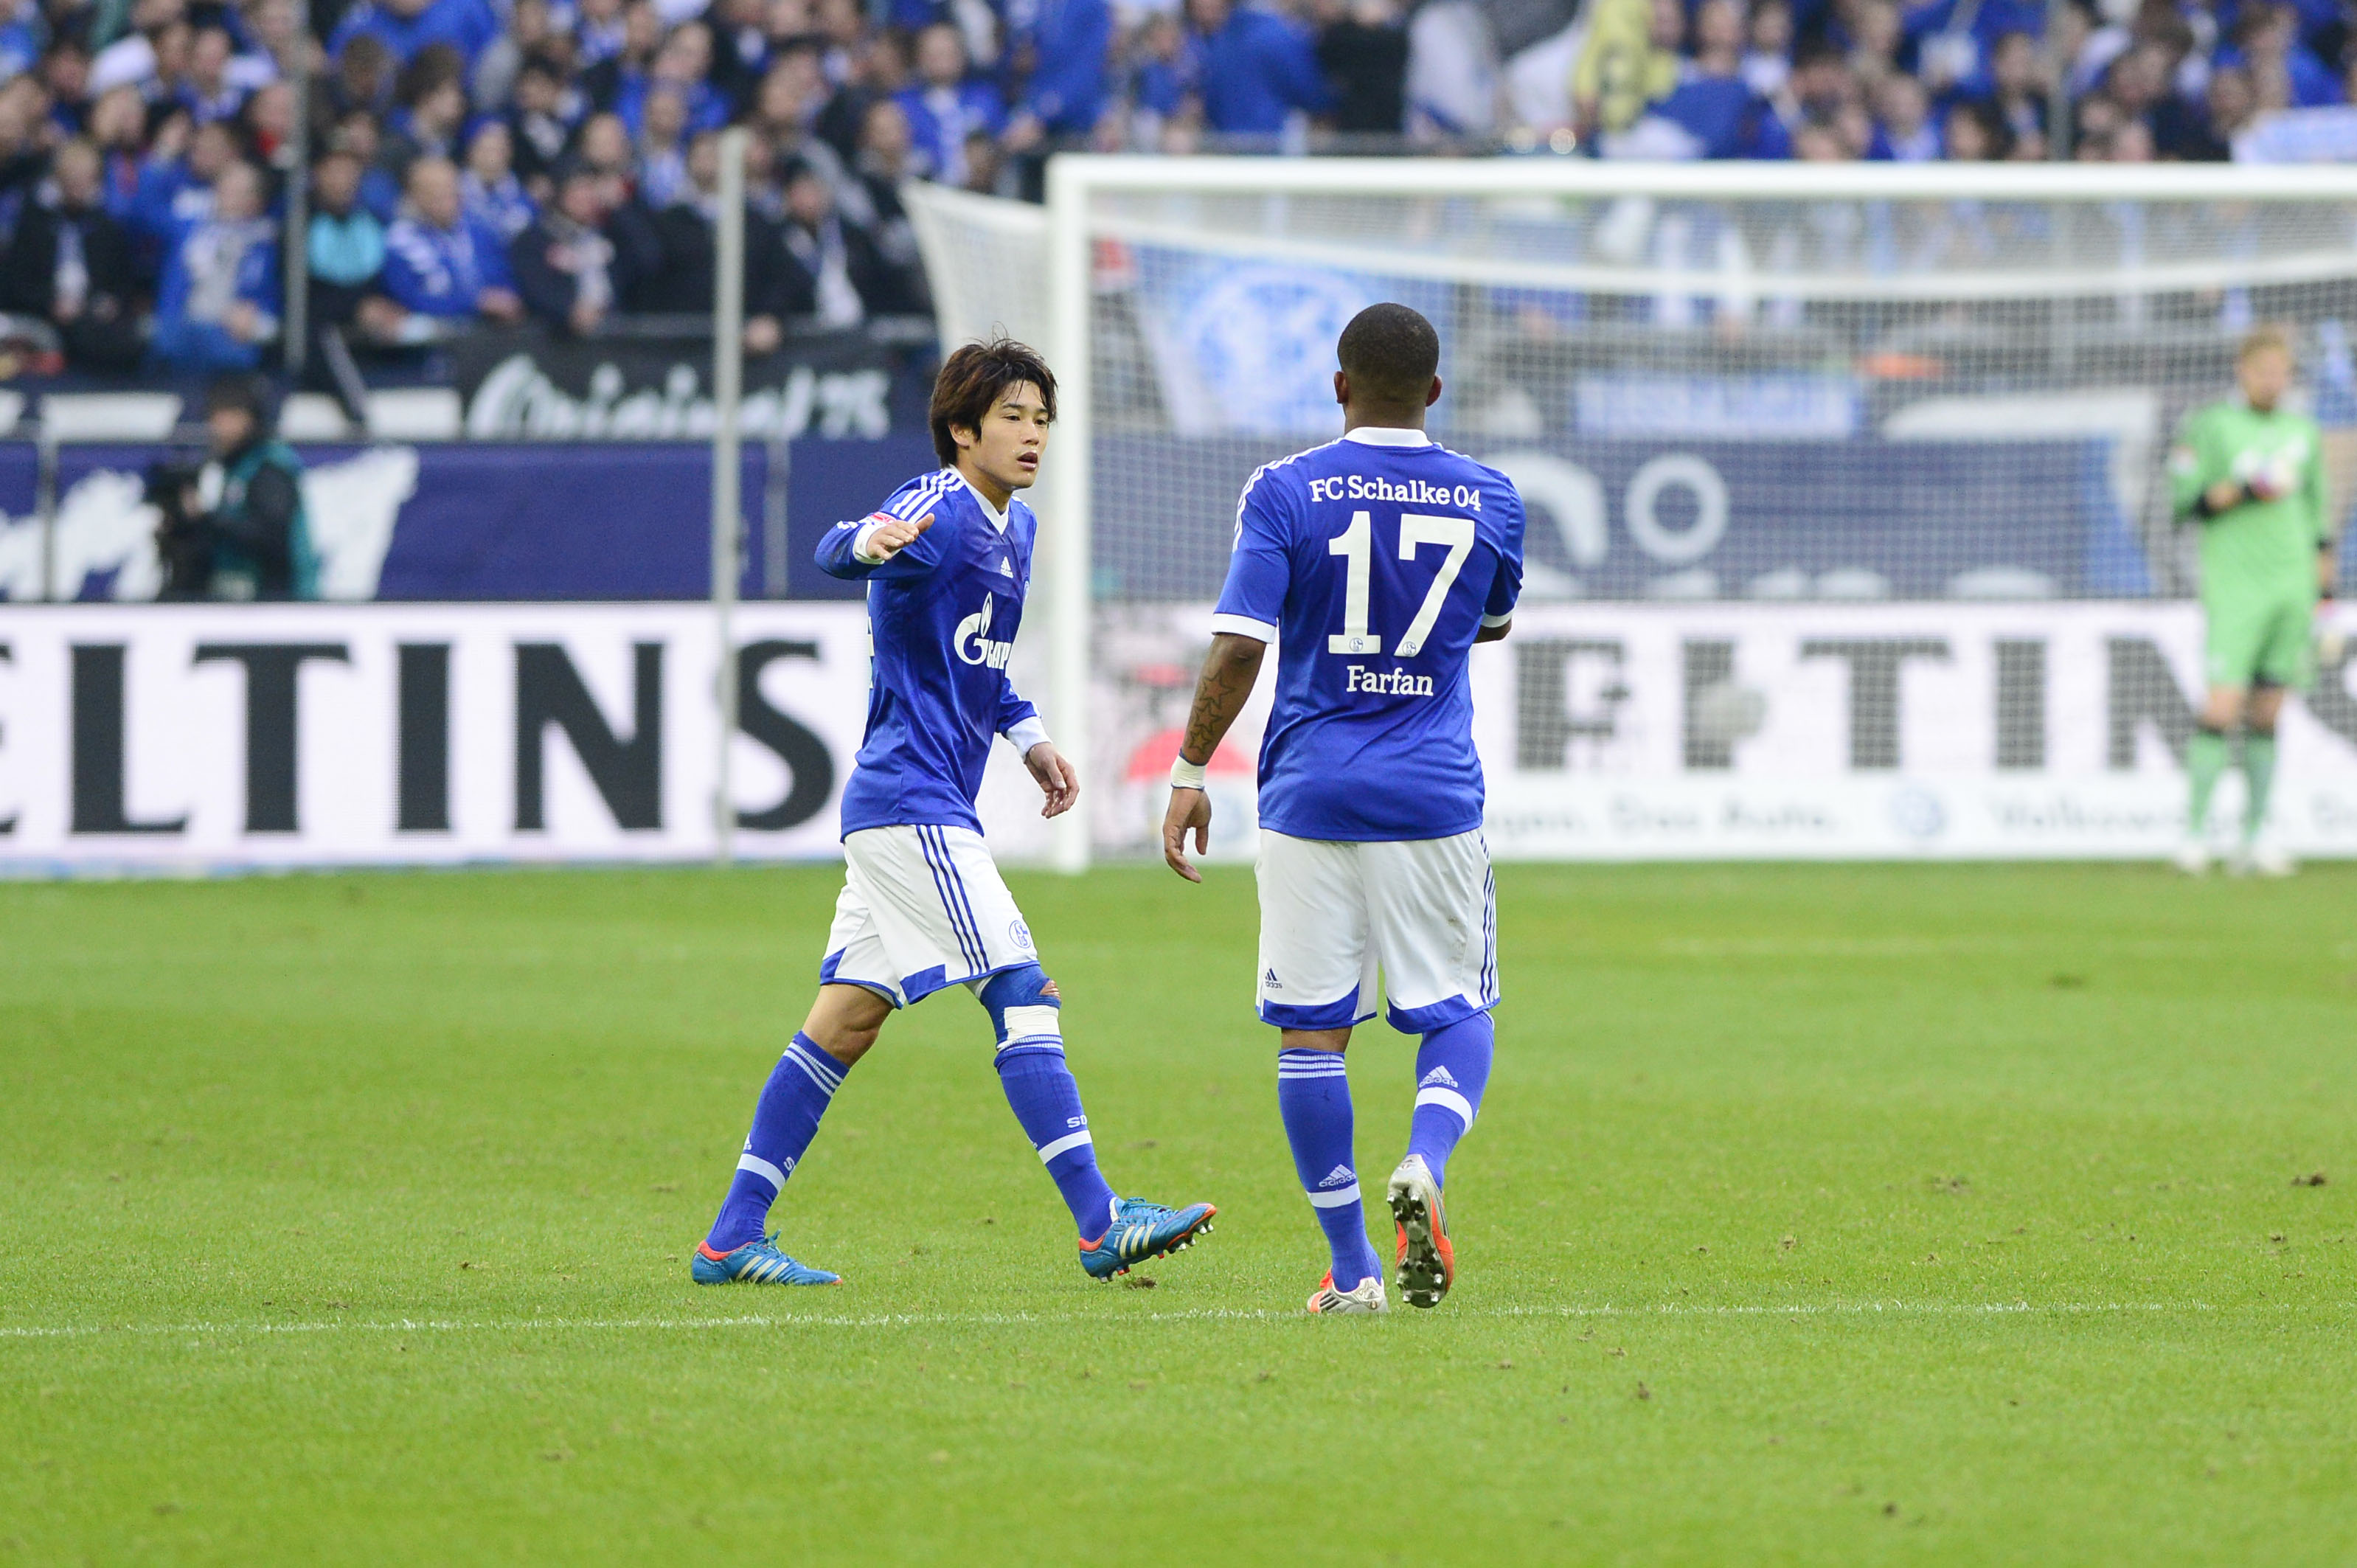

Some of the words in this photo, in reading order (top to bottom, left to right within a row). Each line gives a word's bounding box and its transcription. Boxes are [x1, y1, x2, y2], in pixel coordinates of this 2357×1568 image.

[1309, 476, 1344, 502] FC
[1347, 475, 1451, 504] Schalke
[1454, 485, 1482, 512] 04
[1328, 510, 1475, 657] 17
[1346, 665, 1434, 696] Farfan
[0, 640, 834, 835] LTINS
